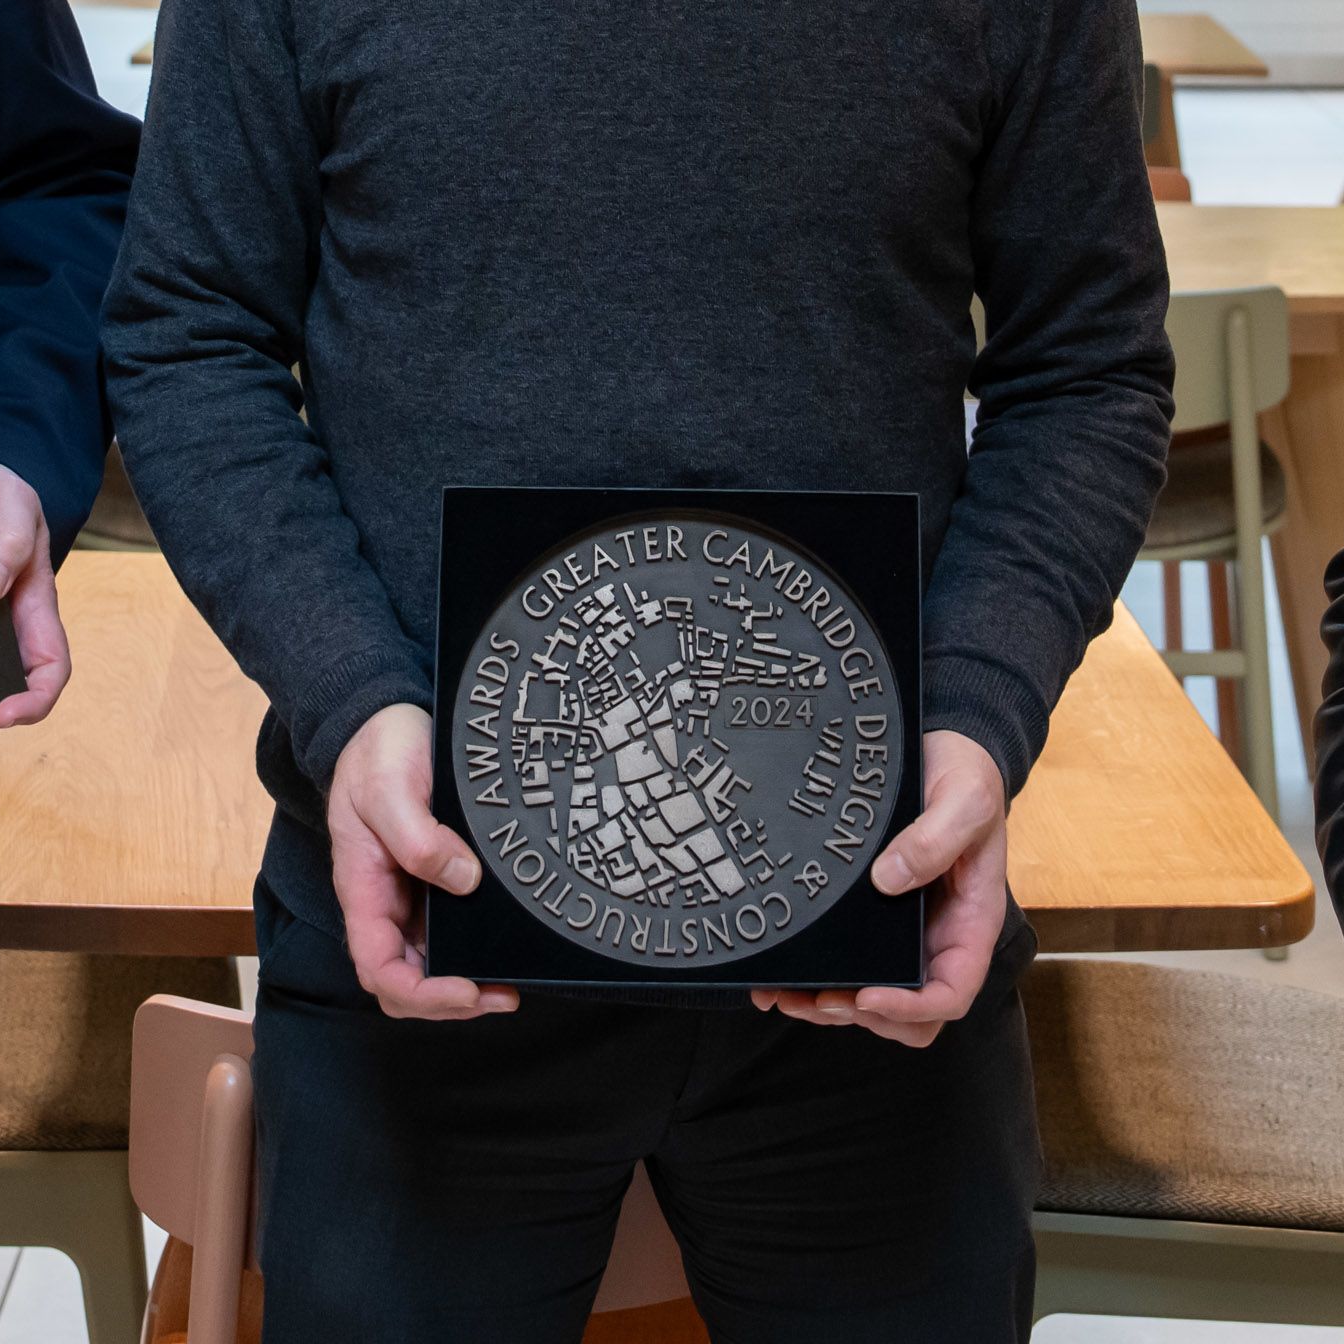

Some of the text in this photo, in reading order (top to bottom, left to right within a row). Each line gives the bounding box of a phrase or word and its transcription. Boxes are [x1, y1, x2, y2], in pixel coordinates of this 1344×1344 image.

[466, 525, 887, 956] GREATER CAMBRIDGE DESIGN & CONSTRUCTION AWARDS
[729, 695, 815, 728] 2024
